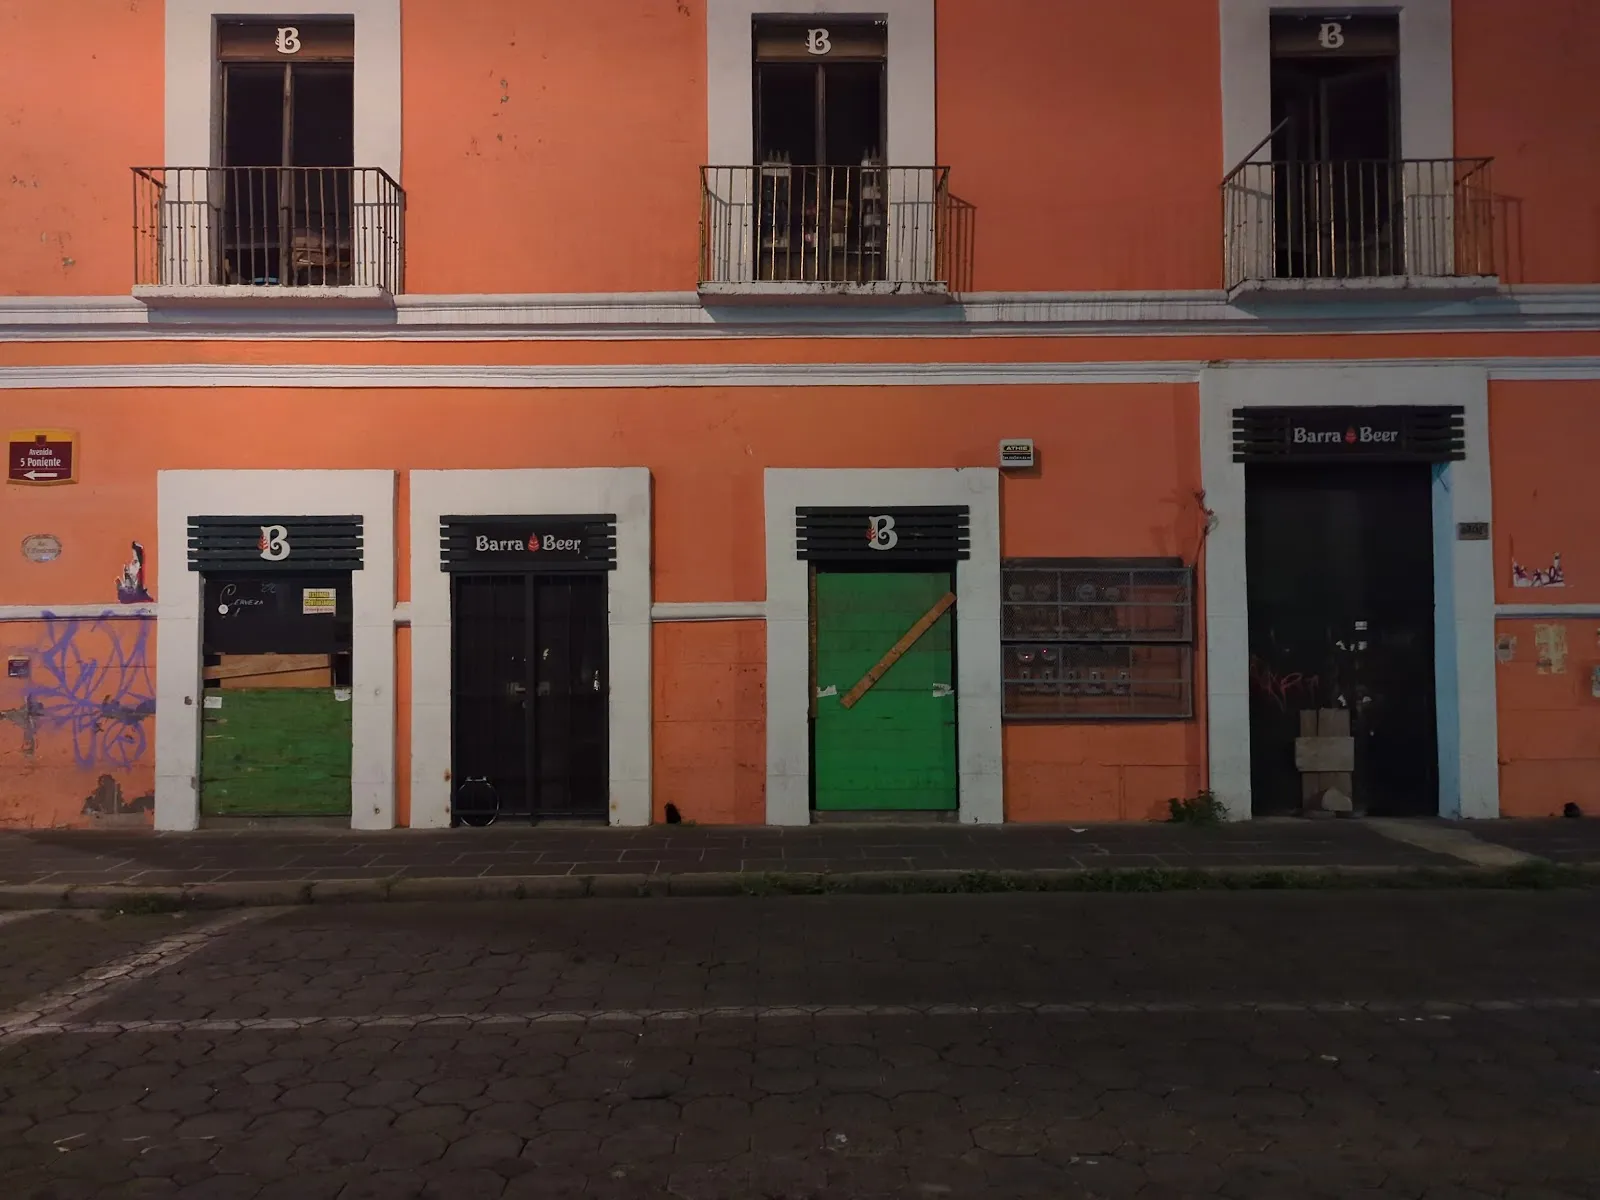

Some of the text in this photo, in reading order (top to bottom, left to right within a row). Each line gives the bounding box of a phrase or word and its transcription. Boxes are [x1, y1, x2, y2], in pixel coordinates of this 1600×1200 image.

[276, 27, 301, 54] B
[806, 28, 831, 55] B
[1319, 22, 1344, 49] B
[1293, 426, 1398, 443] Barra Beer
[20, 457, 61, 468] 5 Poniente
[29, 448, 53, 456] Avenida
[259, 525, 291, 561] B
[475, 534, 581, 552] Barra Beer
[867, 515, 898, 551] B
